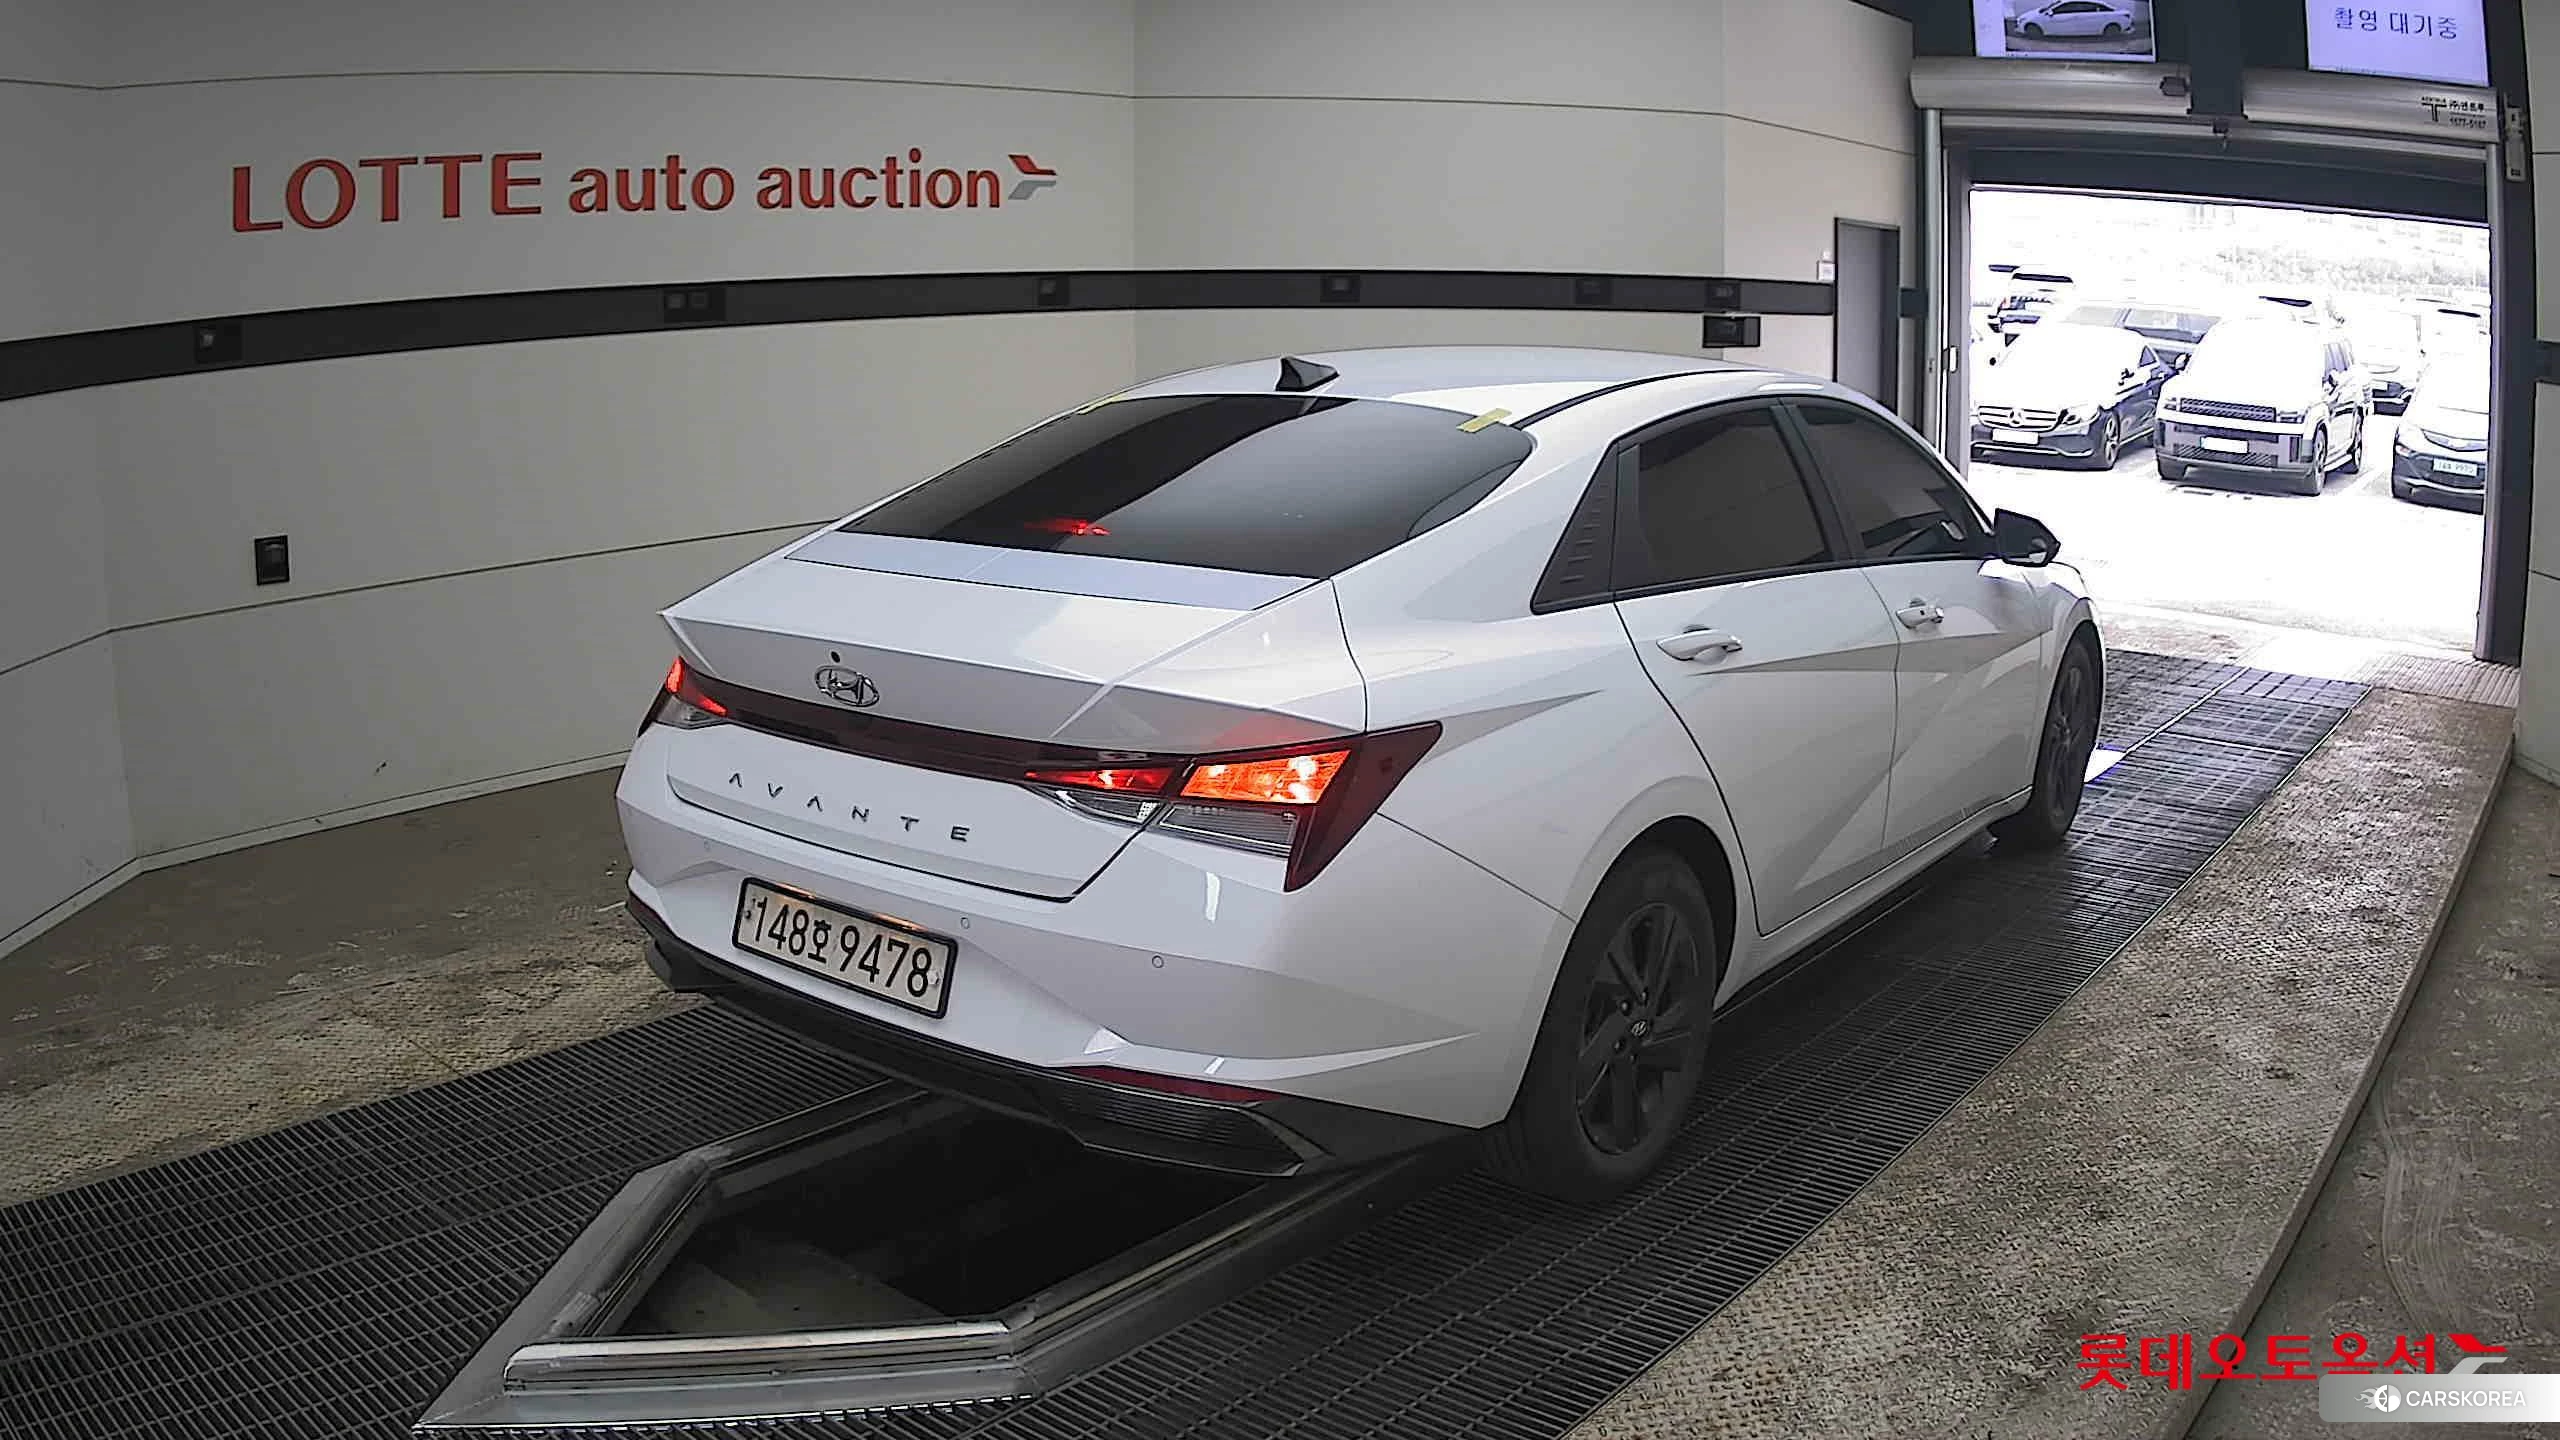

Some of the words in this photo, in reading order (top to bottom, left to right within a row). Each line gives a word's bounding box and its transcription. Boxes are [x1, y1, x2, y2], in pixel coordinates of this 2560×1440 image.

[2335, 7, 2377, 32] 촬영
[2390, 12, 2457, 40] 대기중
[232, 152, 542, 233] LOTTE
[568, 154, 735, 212] auto
[756, 147, 1001, 210] auction
[728, 772, 970, 843] AVANTE
